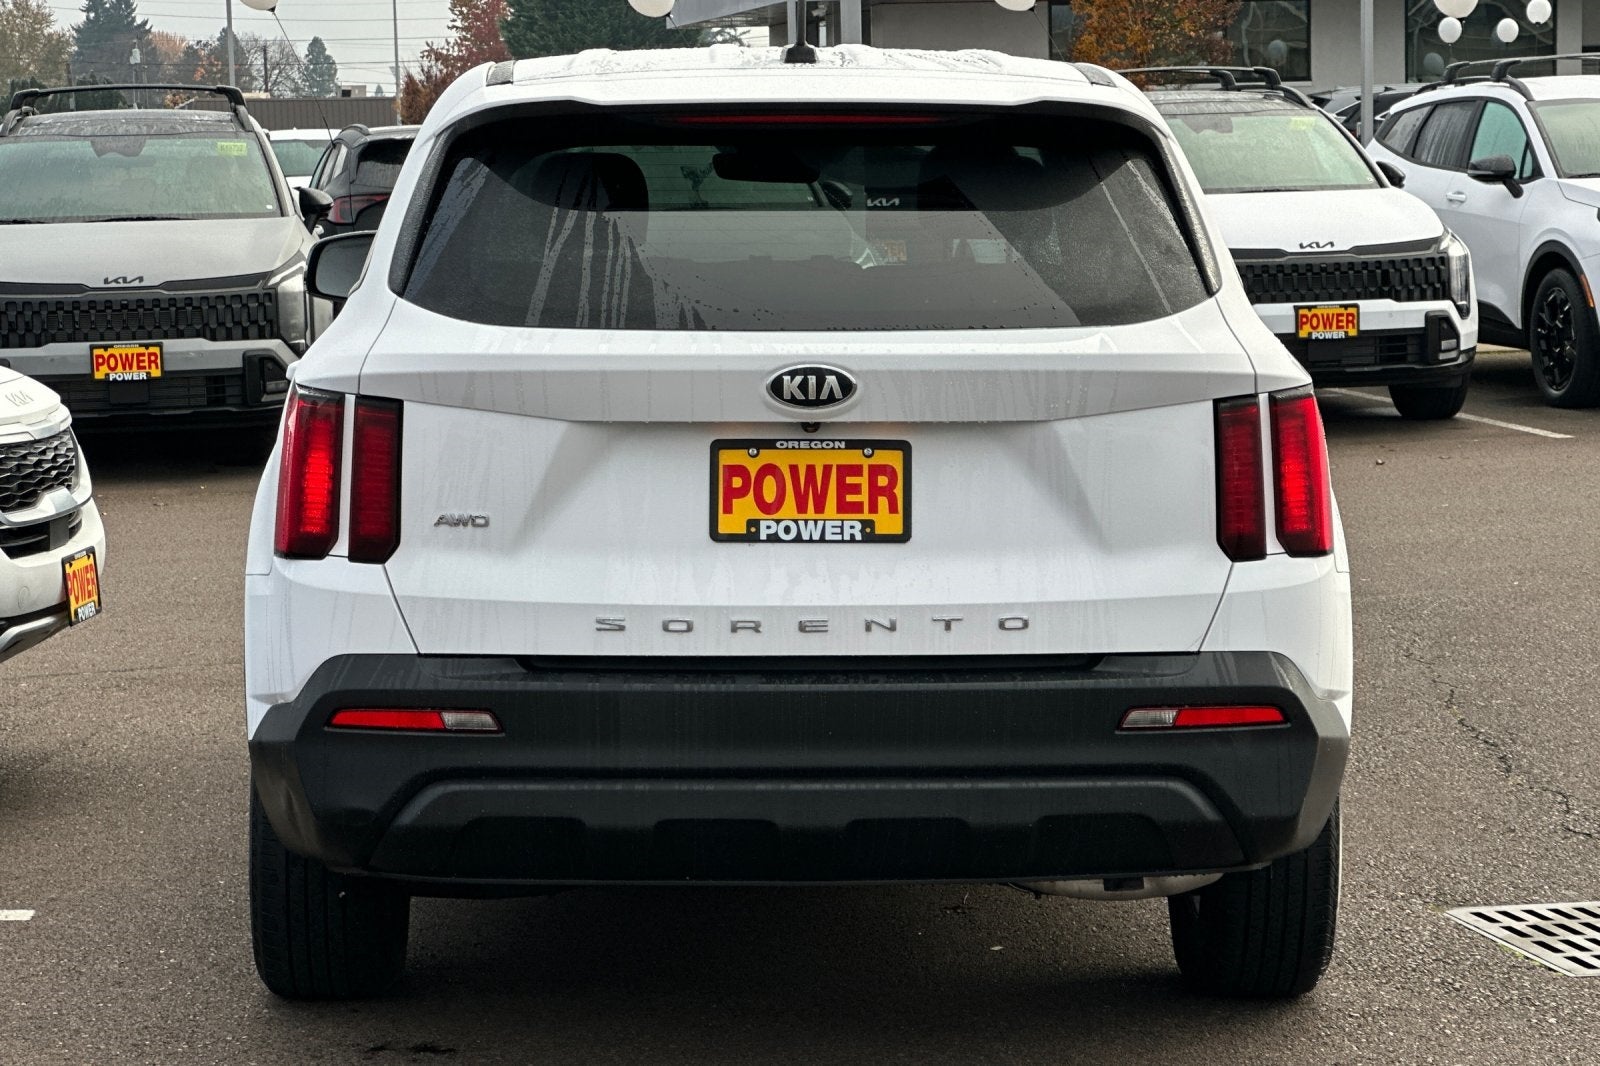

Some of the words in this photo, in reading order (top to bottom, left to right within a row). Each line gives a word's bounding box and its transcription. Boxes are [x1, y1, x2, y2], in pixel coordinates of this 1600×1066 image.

[867, 198, 900, 207] KIA
[1299, 241, 1335, 249] KIA
[103, 276, 144, 285] KIA
[1299, 312, 1357, 331] POWER
[1311, 331, 1346, 340] POWER
[95, 352, 160, 372] POWER
[109, 373, 147, 381] POWER
[782, 375, 843, 400] KIA
[775, 440, 846, 449] OREGON
[722, 463, 899, 515] POWER
[433, 514, 490, 528] AWD
[759, 520, 862, 541] POWER
[66, 563, 97, 605] POWER
[595, 615, 1029, 633] SORENTO
